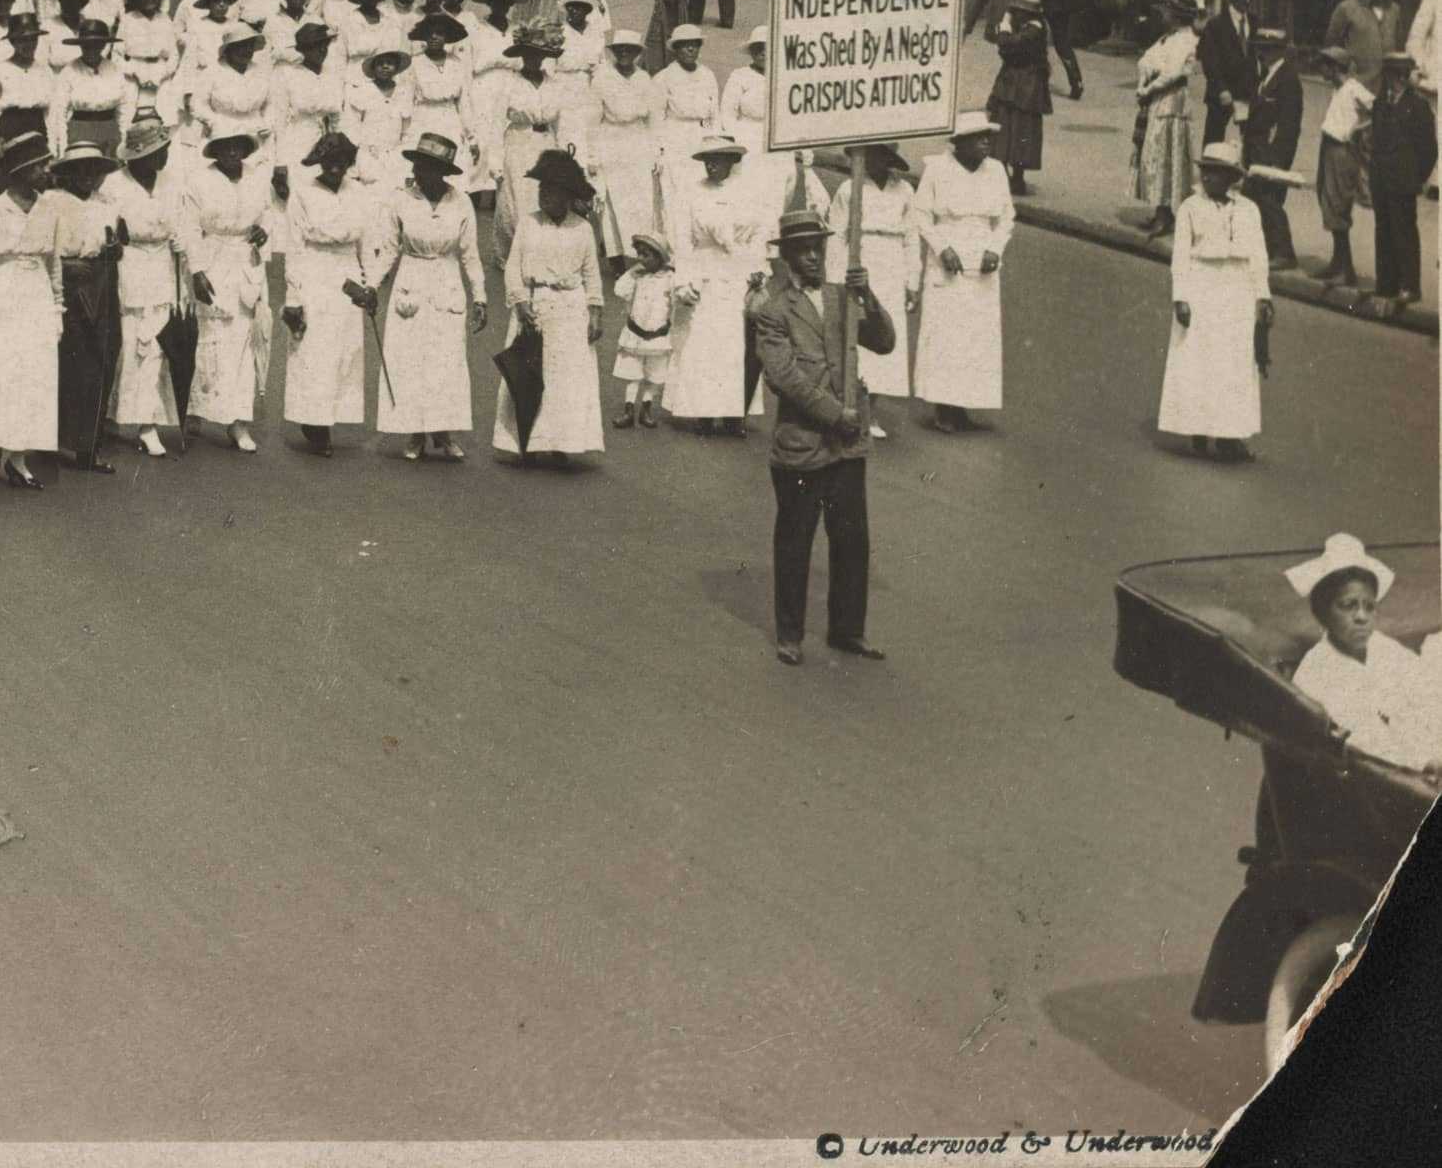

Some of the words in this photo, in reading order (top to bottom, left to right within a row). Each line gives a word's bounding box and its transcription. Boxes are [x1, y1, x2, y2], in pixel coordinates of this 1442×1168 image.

[784, 34, 816, 70] Was
[820, 32, 856, 68] Shed
[862, 28, 880, 70] By
[883, 27, 895, 63] A
[899, 25, 949, 66] Negro
[788, 78, 866, 115] CRISPUS
[869, 71, 942, 108] ATTUCKS
